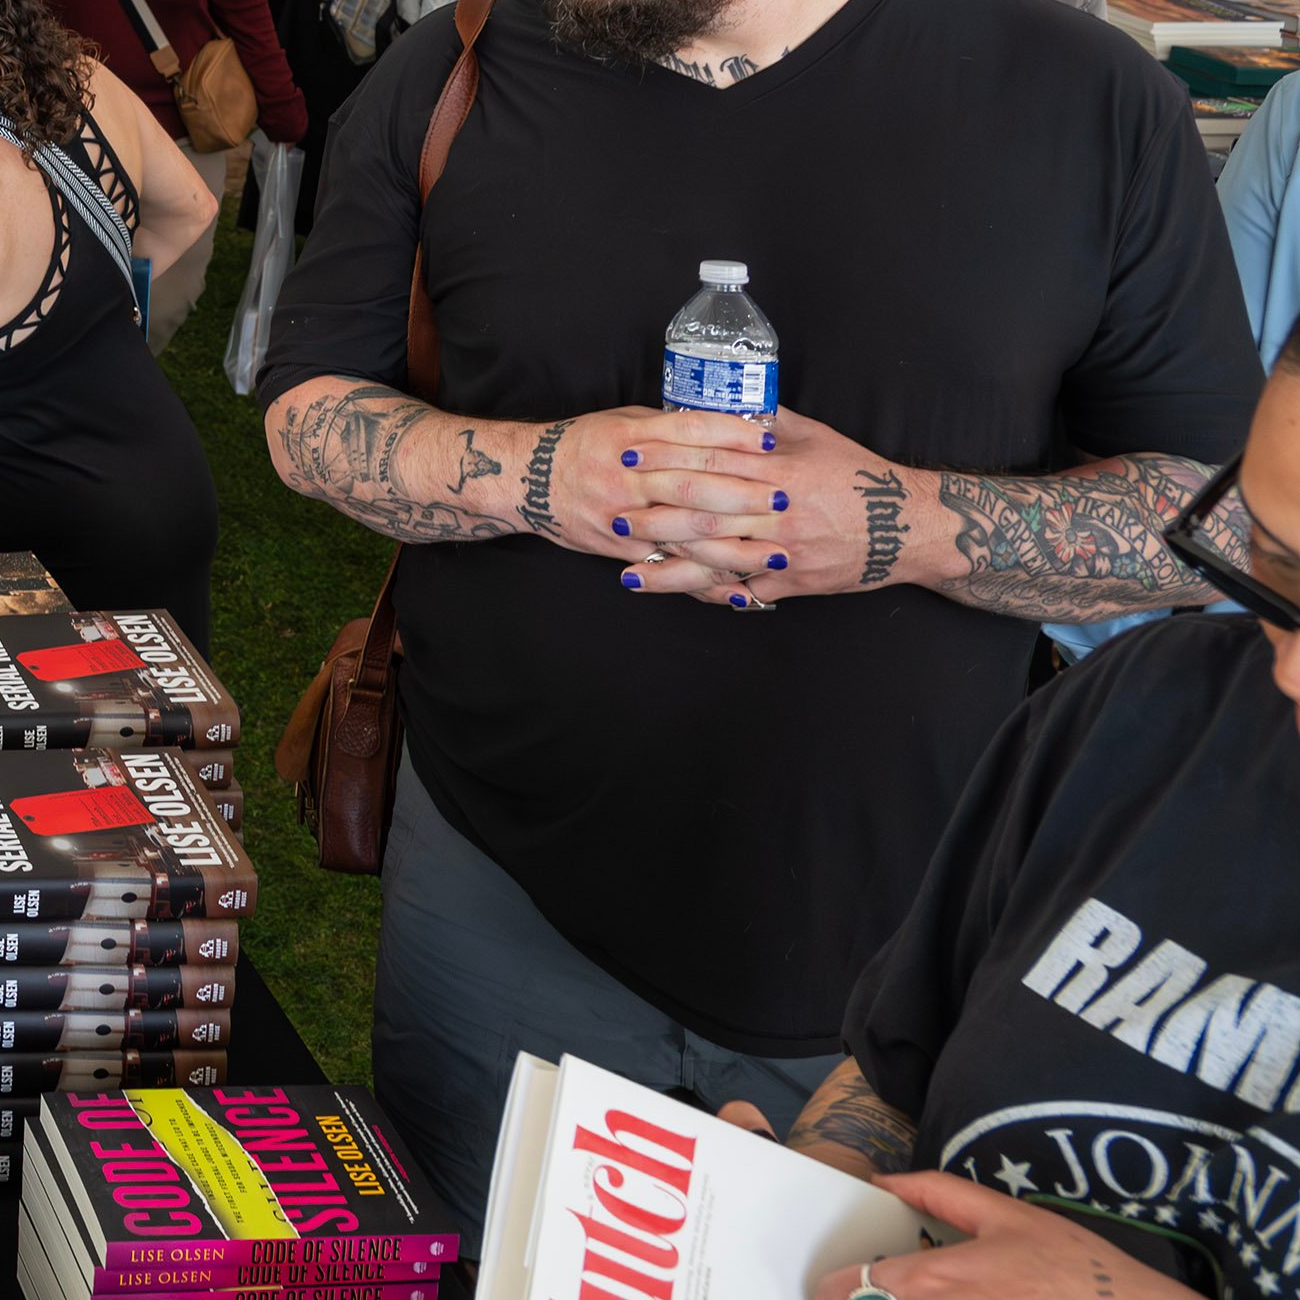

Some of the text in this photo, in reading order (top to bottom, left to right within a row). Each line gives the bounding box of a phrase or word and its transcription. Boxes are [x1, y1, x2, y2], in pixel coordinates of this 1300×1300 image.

[942, 477, 1053, 577] MEIN GARTEN
[1149, 551, 1182, 589] BOY
[120, 754, 223, 867] LISE OLSEN
[1021, 897, 1300, 1114] RAM
[131, 1238, 402, 1264] LISE OLSEN CODE OF SILENCE
